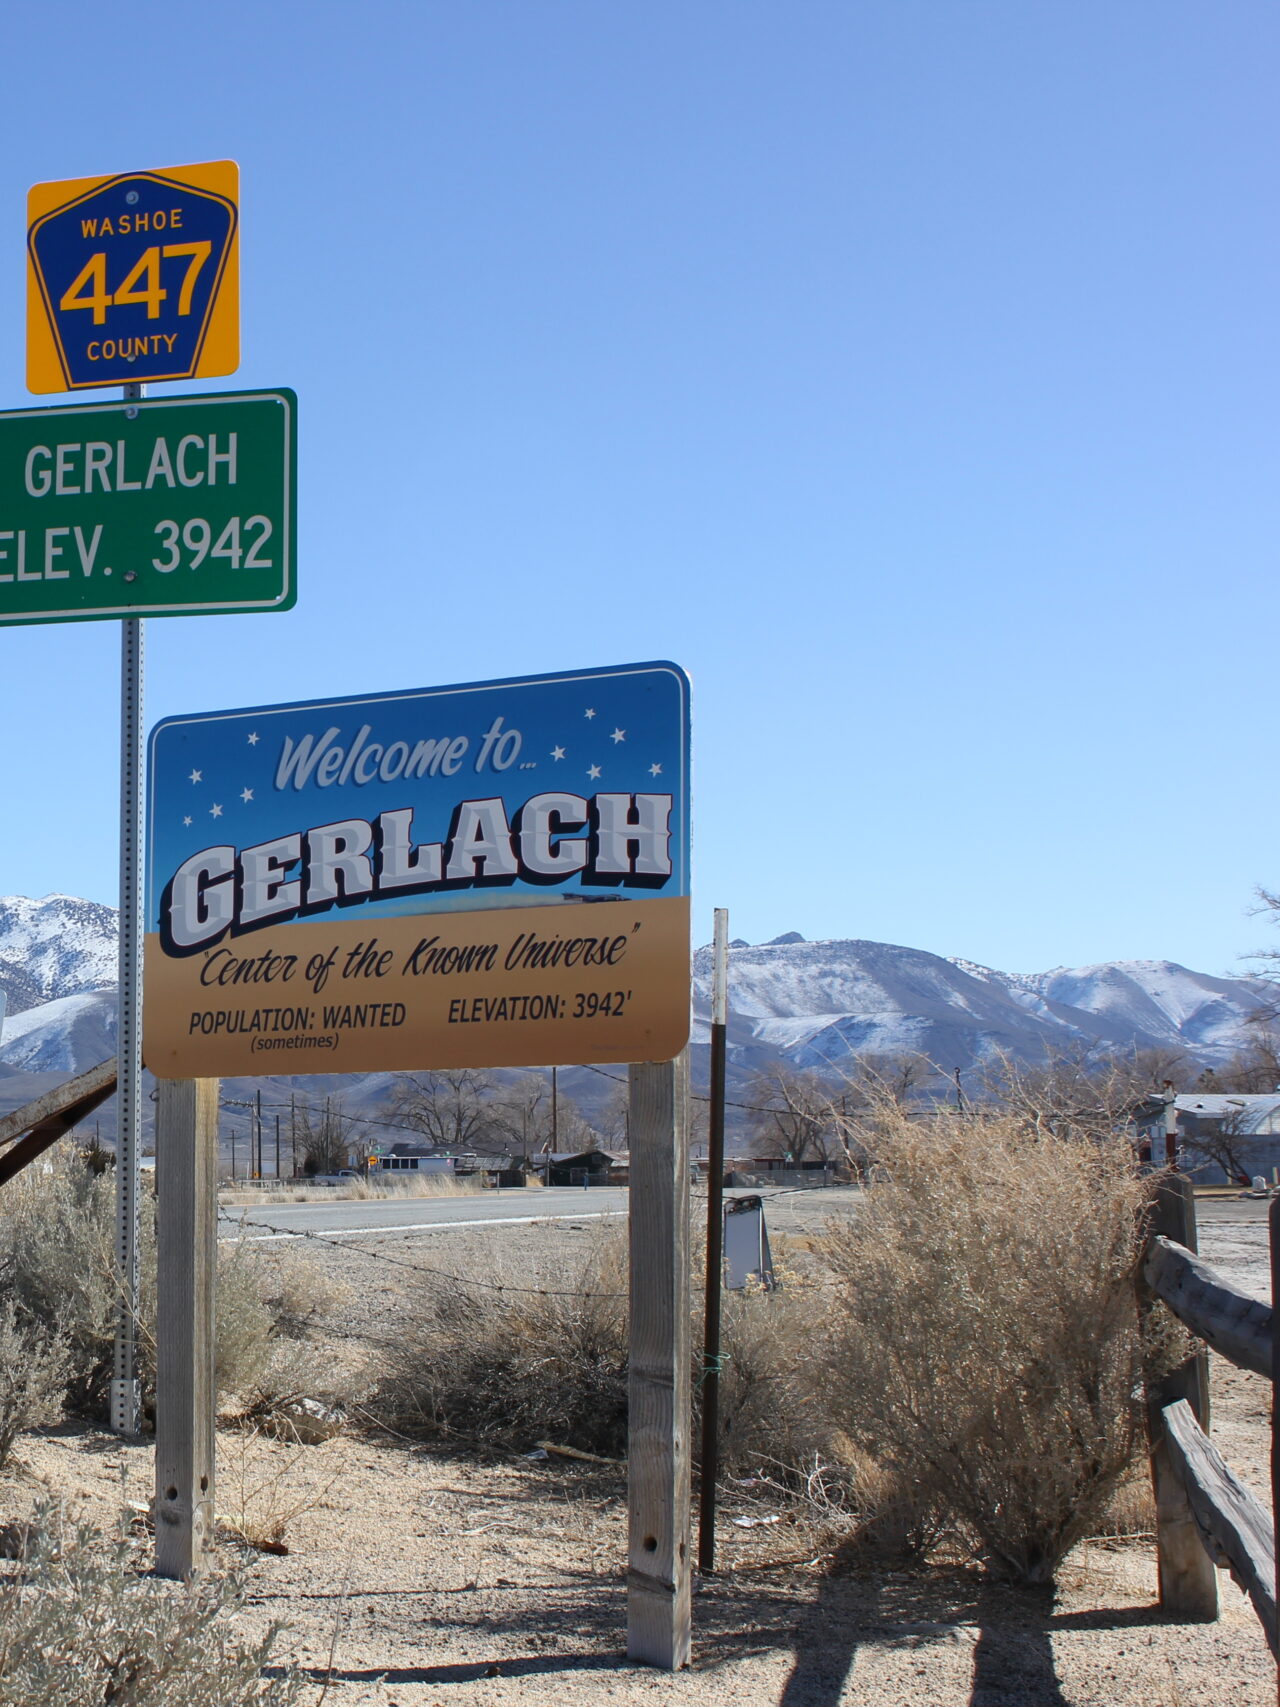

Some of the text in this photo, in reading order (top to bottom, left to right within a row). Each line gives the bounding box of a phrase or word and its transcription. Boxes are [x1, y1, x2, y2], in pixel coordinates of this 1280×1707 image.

[81, 208, 184, 238] WASHOE
[59, 240, 212, 325] 447
[87, 333, 178, 361] COUNTY
[24, 432, 238, 498] GERLACH
[152, 515, 274, 574] 3942
[275, 716, 537, 790] Welcome to...
[162, 791, 674, 954] GERLACH
[200, 921, 641, 994] "Center of the Known Universe"
[189, 1002, 407, 1035] POPULATION: WANTED
[447, 990, 633, 1023] ELEVATION: 3942'
[250, 1032, 340, 1053] (sometimes)
